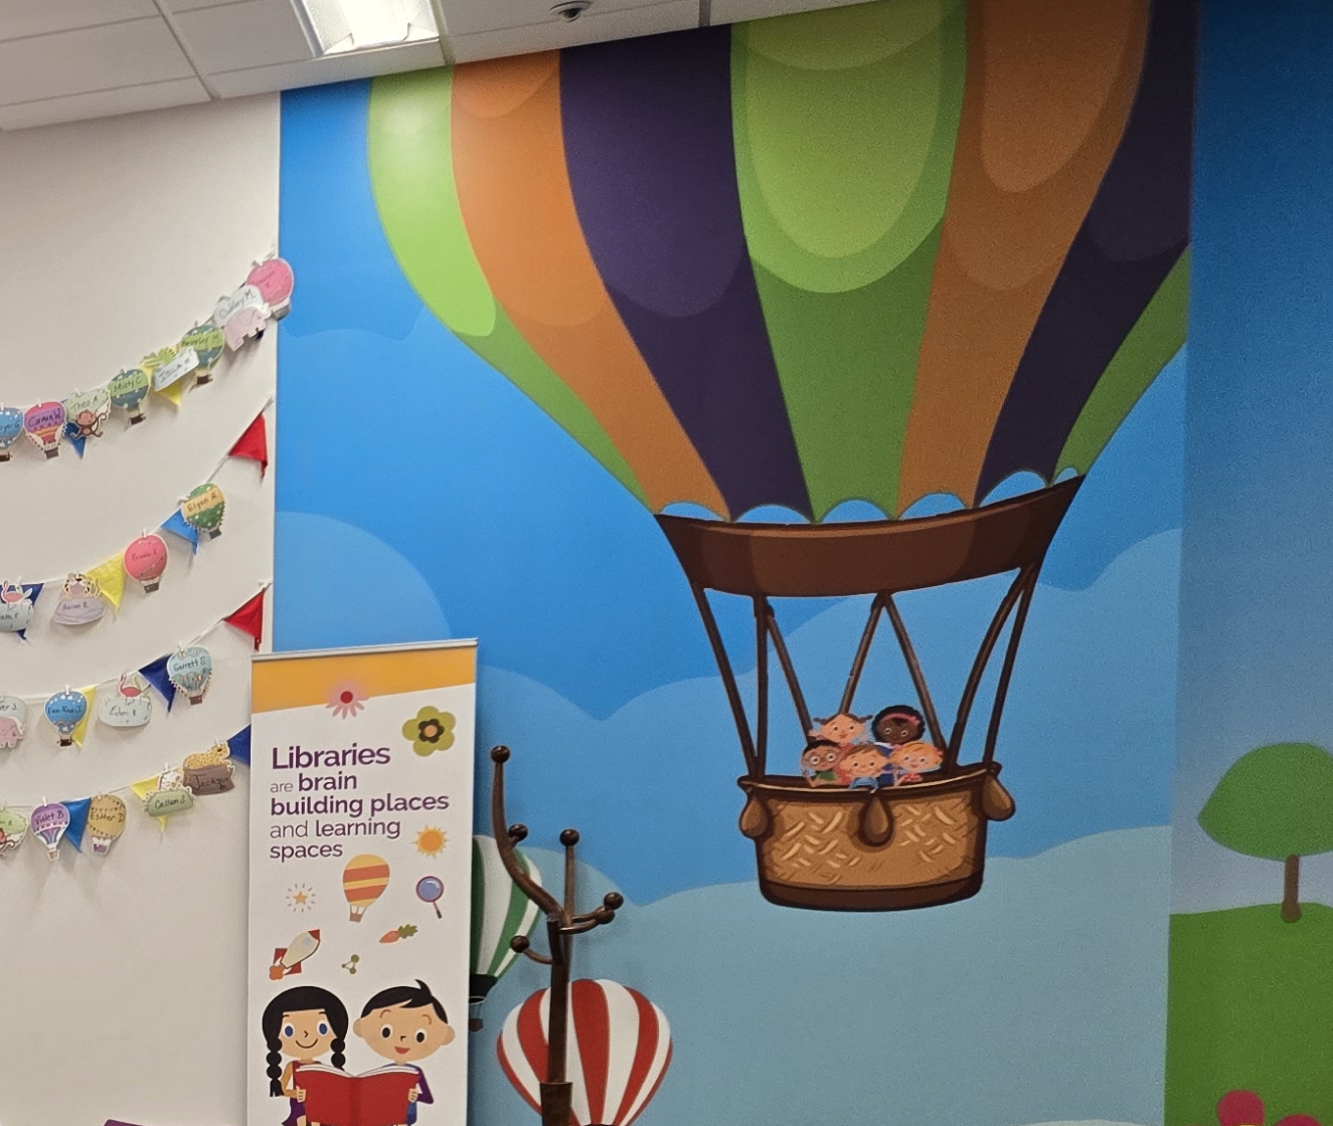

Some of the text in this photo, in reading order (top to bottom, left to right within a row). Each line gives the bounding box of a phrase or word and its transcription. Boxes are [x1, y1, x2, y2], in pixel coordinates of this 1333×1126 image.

[272, 743, 391, 770] Libraries
[270, 772, 358, 793] are brain
[270, 793, 450, 818] building places
[270, 818, 401, 839] and learning
[270, 841, 343, 863] spaces
